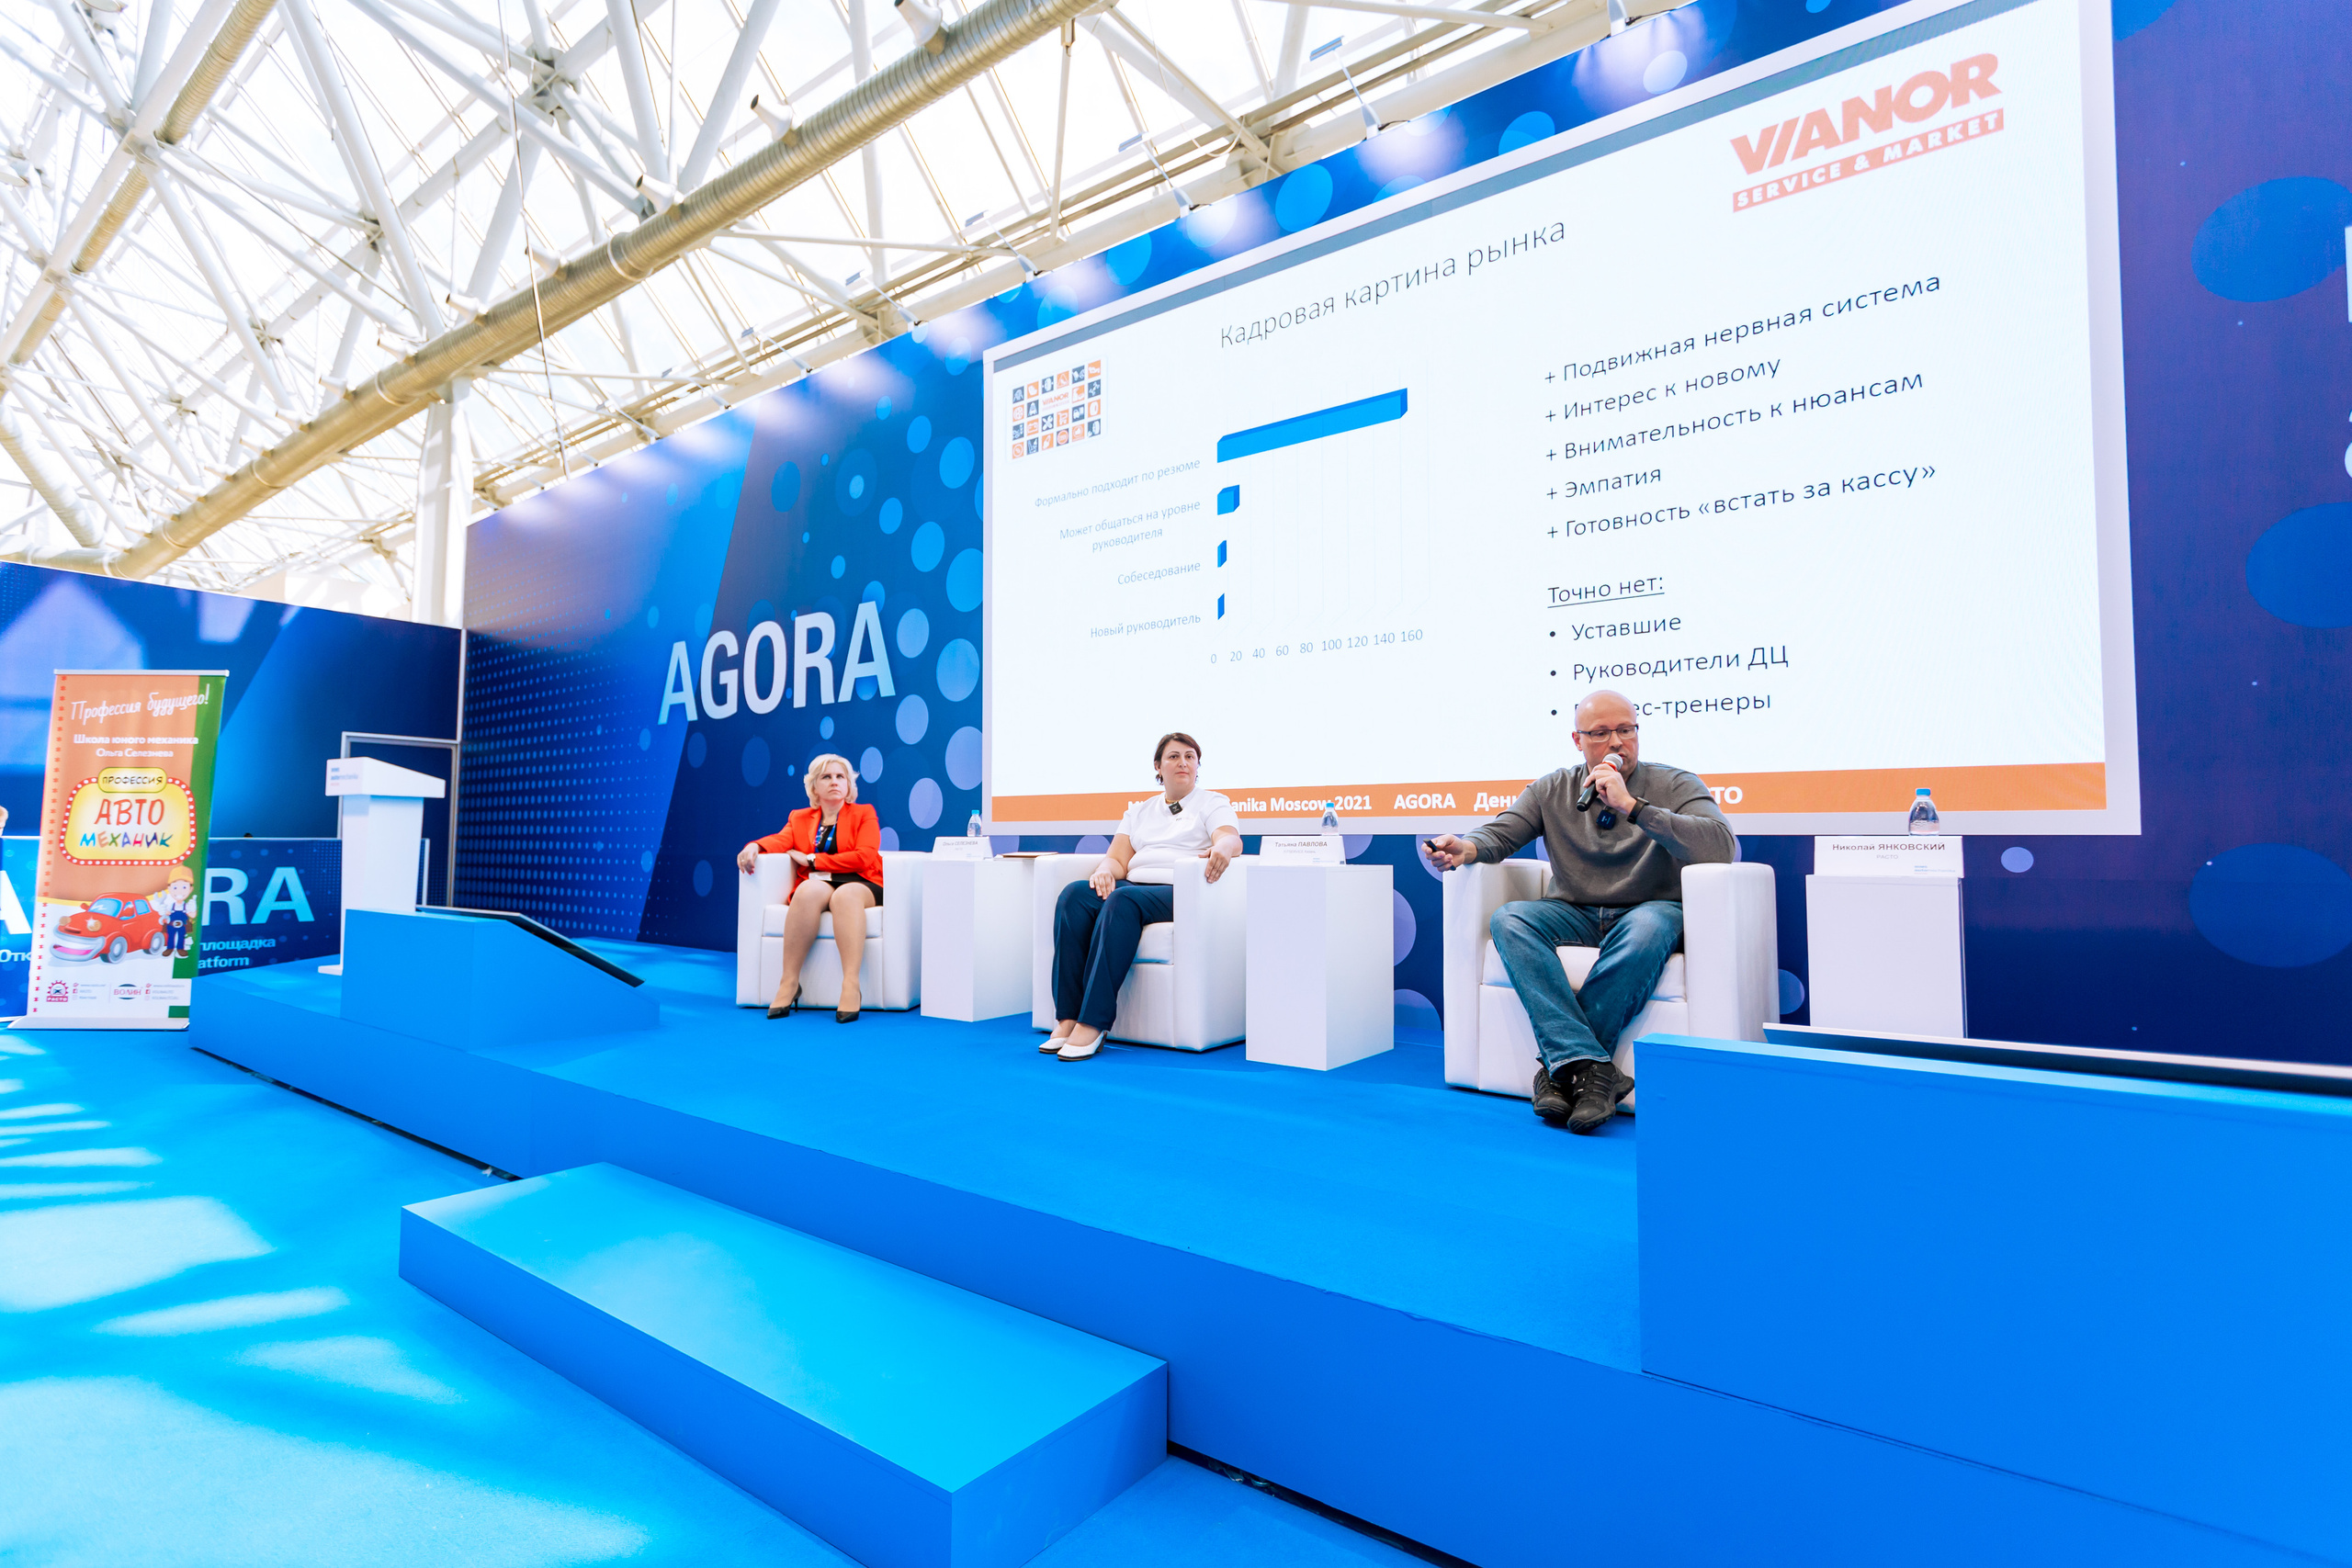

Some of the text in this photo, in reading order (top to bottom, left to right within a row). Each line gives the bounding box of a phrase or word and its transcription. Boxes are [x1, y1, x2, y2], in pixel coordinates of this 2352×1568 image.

[1730, 52, 2003, 175] VIANOR
[1737, 113, 1998, 208] SERVICE & MARKET
[1221, 221, 1565, 348] Кадровая картина рынка
[1563, 335, 1695, 382] Подвижная
[1704, 308, 1814, 347] нервная
[1822, 275, 1941, 318] система
[1564, 385, 1657, 420] Интерес
[1665, 381, 1677, 398] к
[1685, 356, 1781, 393] новому
[1565, 407, 1761, 460] Внимательность
[1770, 402, 1782, 417] к
[1792, 372, 1924, 413] нюансам
[1035, 459, 1201, 507] Формально подходит по резюме
[1565, 468, 1662, 499] Эмпатия
[1566, 503, 1690, 537] Готовность
[1698, 488, 1794, 516] «встать
[1804, 480, 1831, 500] за
[1841, 465, 1936, 495] кассу»
[1059, 501, 1201, 540] Может общаться на уровне
[1092, 528, 1163, 553] руководителя
[1117, 562, 1201, 585] Собеседование
[1548, 574, 1664, 604] Точно нет:
[1091, 615, 1201, 637] Новый руководитель
[1572, 615, 1681, 641] Уставшие
[1210, 628, 1423, 663] 0 20 40 60 80 100 120 140 160
[658, 601, 896, 726] AGORA
[1573, 645, 1789, 683] Руководители ДЦ
[71, 683, 209, 726] Профессия будущего!
[74, 734, 109, 744] Школа
[96, 748, 174, 757] Ольга Селезнева
[102, 776, 164, 785] ПРОФЕССИЯ
[1707, 785, 1743, 805] ТО
[94, 798, 164, 826] АВТО
[1334, 795, 1372, 810] 2021
[1393, 793, 1456, 809] AGORA
[79, 830, 174, 848] МЕХАНИК
[1878, 842, 1945, 851] ЯНКОВСКИЙ
[198, 955, 250, 969] atform
